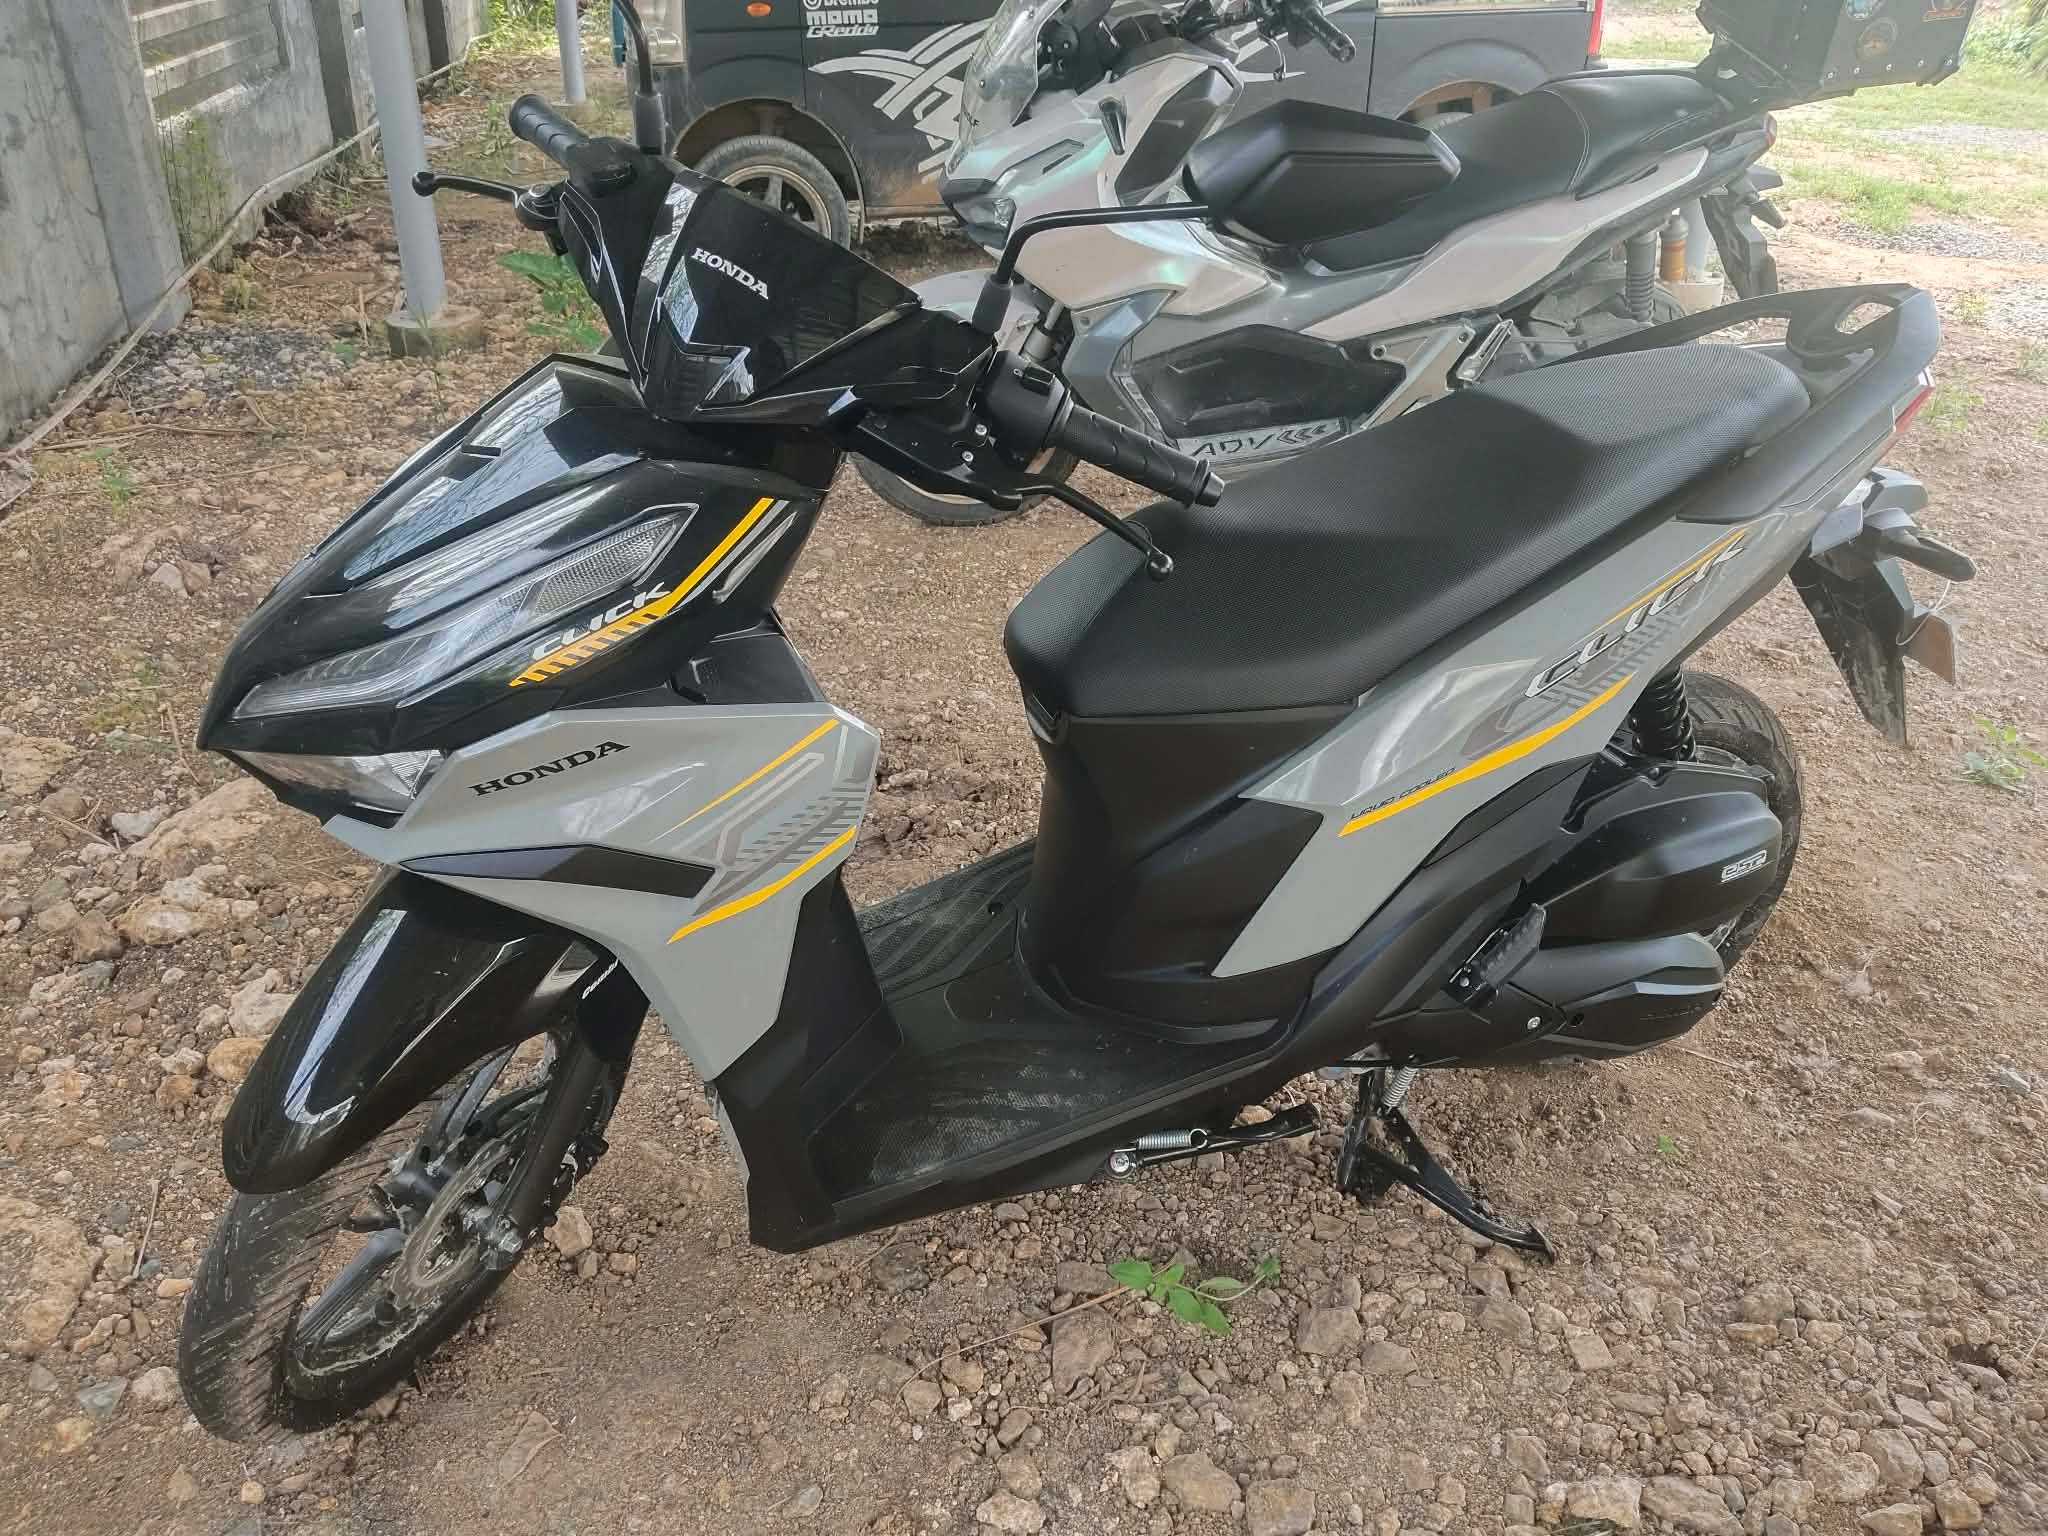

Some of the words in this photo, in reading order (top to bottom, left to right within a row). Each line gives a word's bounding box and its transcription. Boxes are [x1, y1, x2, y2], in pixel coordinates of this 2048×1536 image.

[806, 8, 878, 25] momo
[806, 24, 879, 38] GReddy
[691, 247, 769, 300] HONDA
[1191, 433, 1276, 457] ADV
[532, 581, 671, 660] CLICK
[1525, 534, 1745, 697] CLICK
[468, 741, 631, 796] HONDA
[1399, 767, 1456, 799] COOLED
